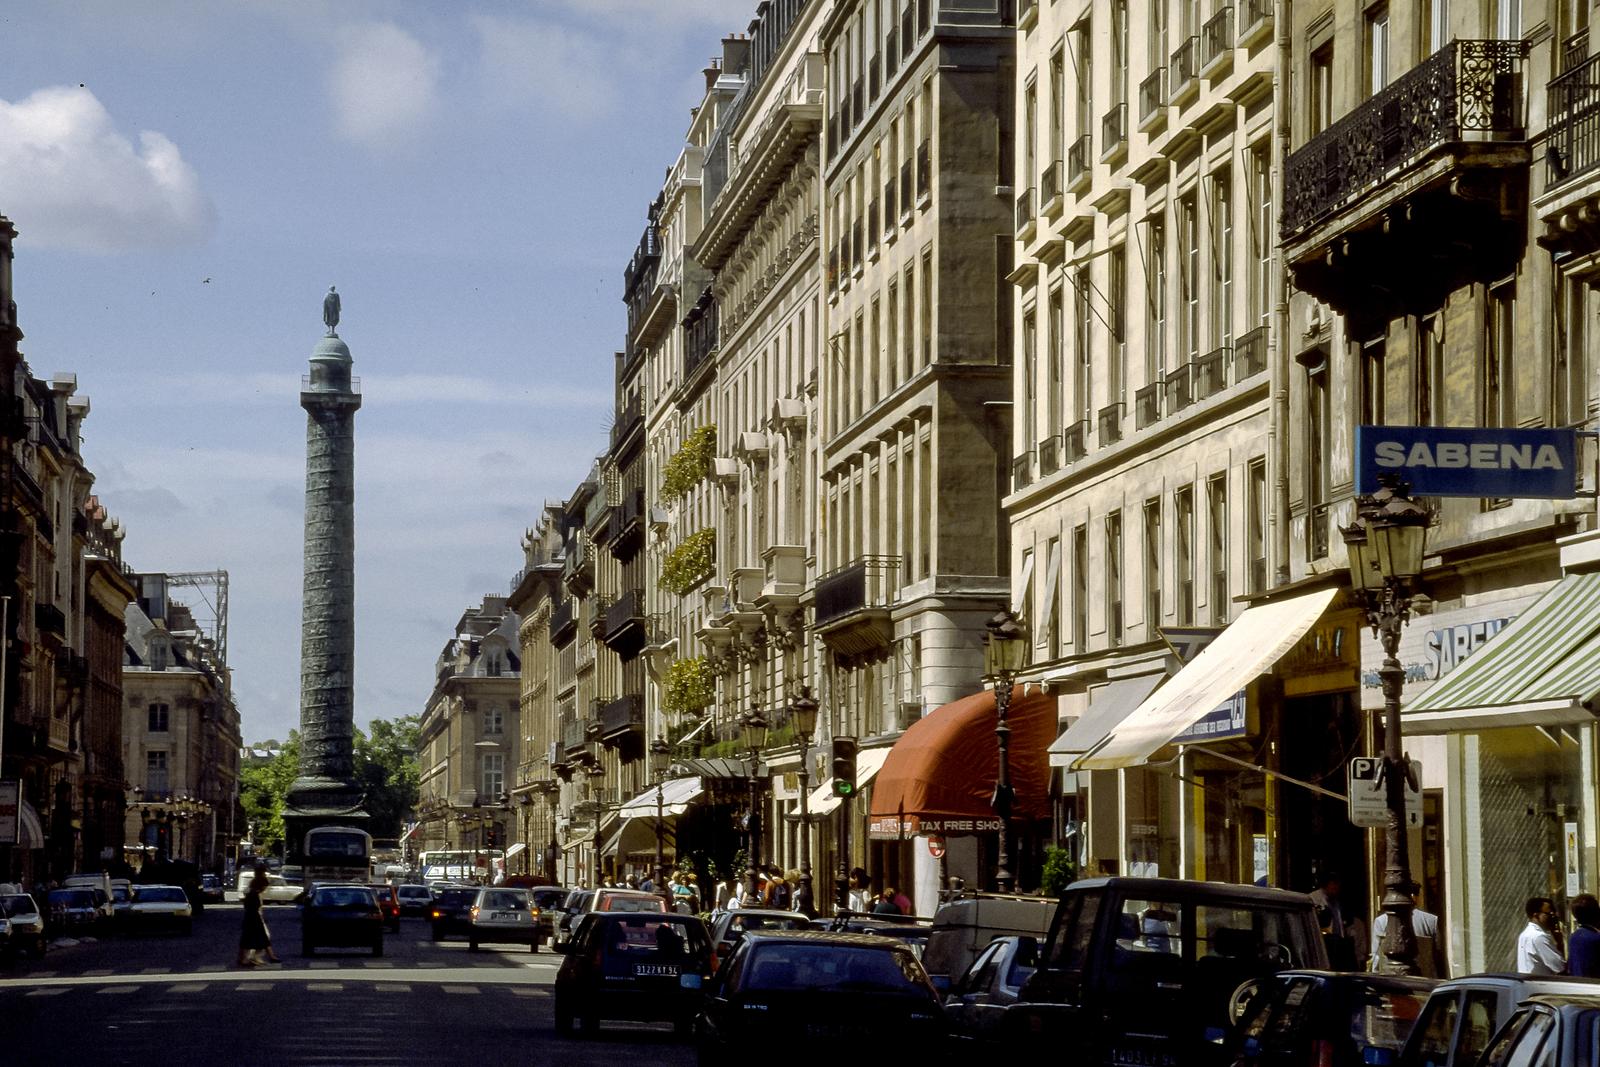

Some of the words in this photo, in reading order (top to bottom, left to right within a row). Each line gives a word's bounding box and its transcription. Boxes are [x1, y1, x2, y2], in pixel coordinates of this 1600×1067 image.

[1375, 441, 1564, 471] SABENA
[1356, 760, 1371, 778] P
[920, 821, 941, 831] TAX
[944, 821, 974, 831] FREE
[976, 821, 1005, 831] SHO
